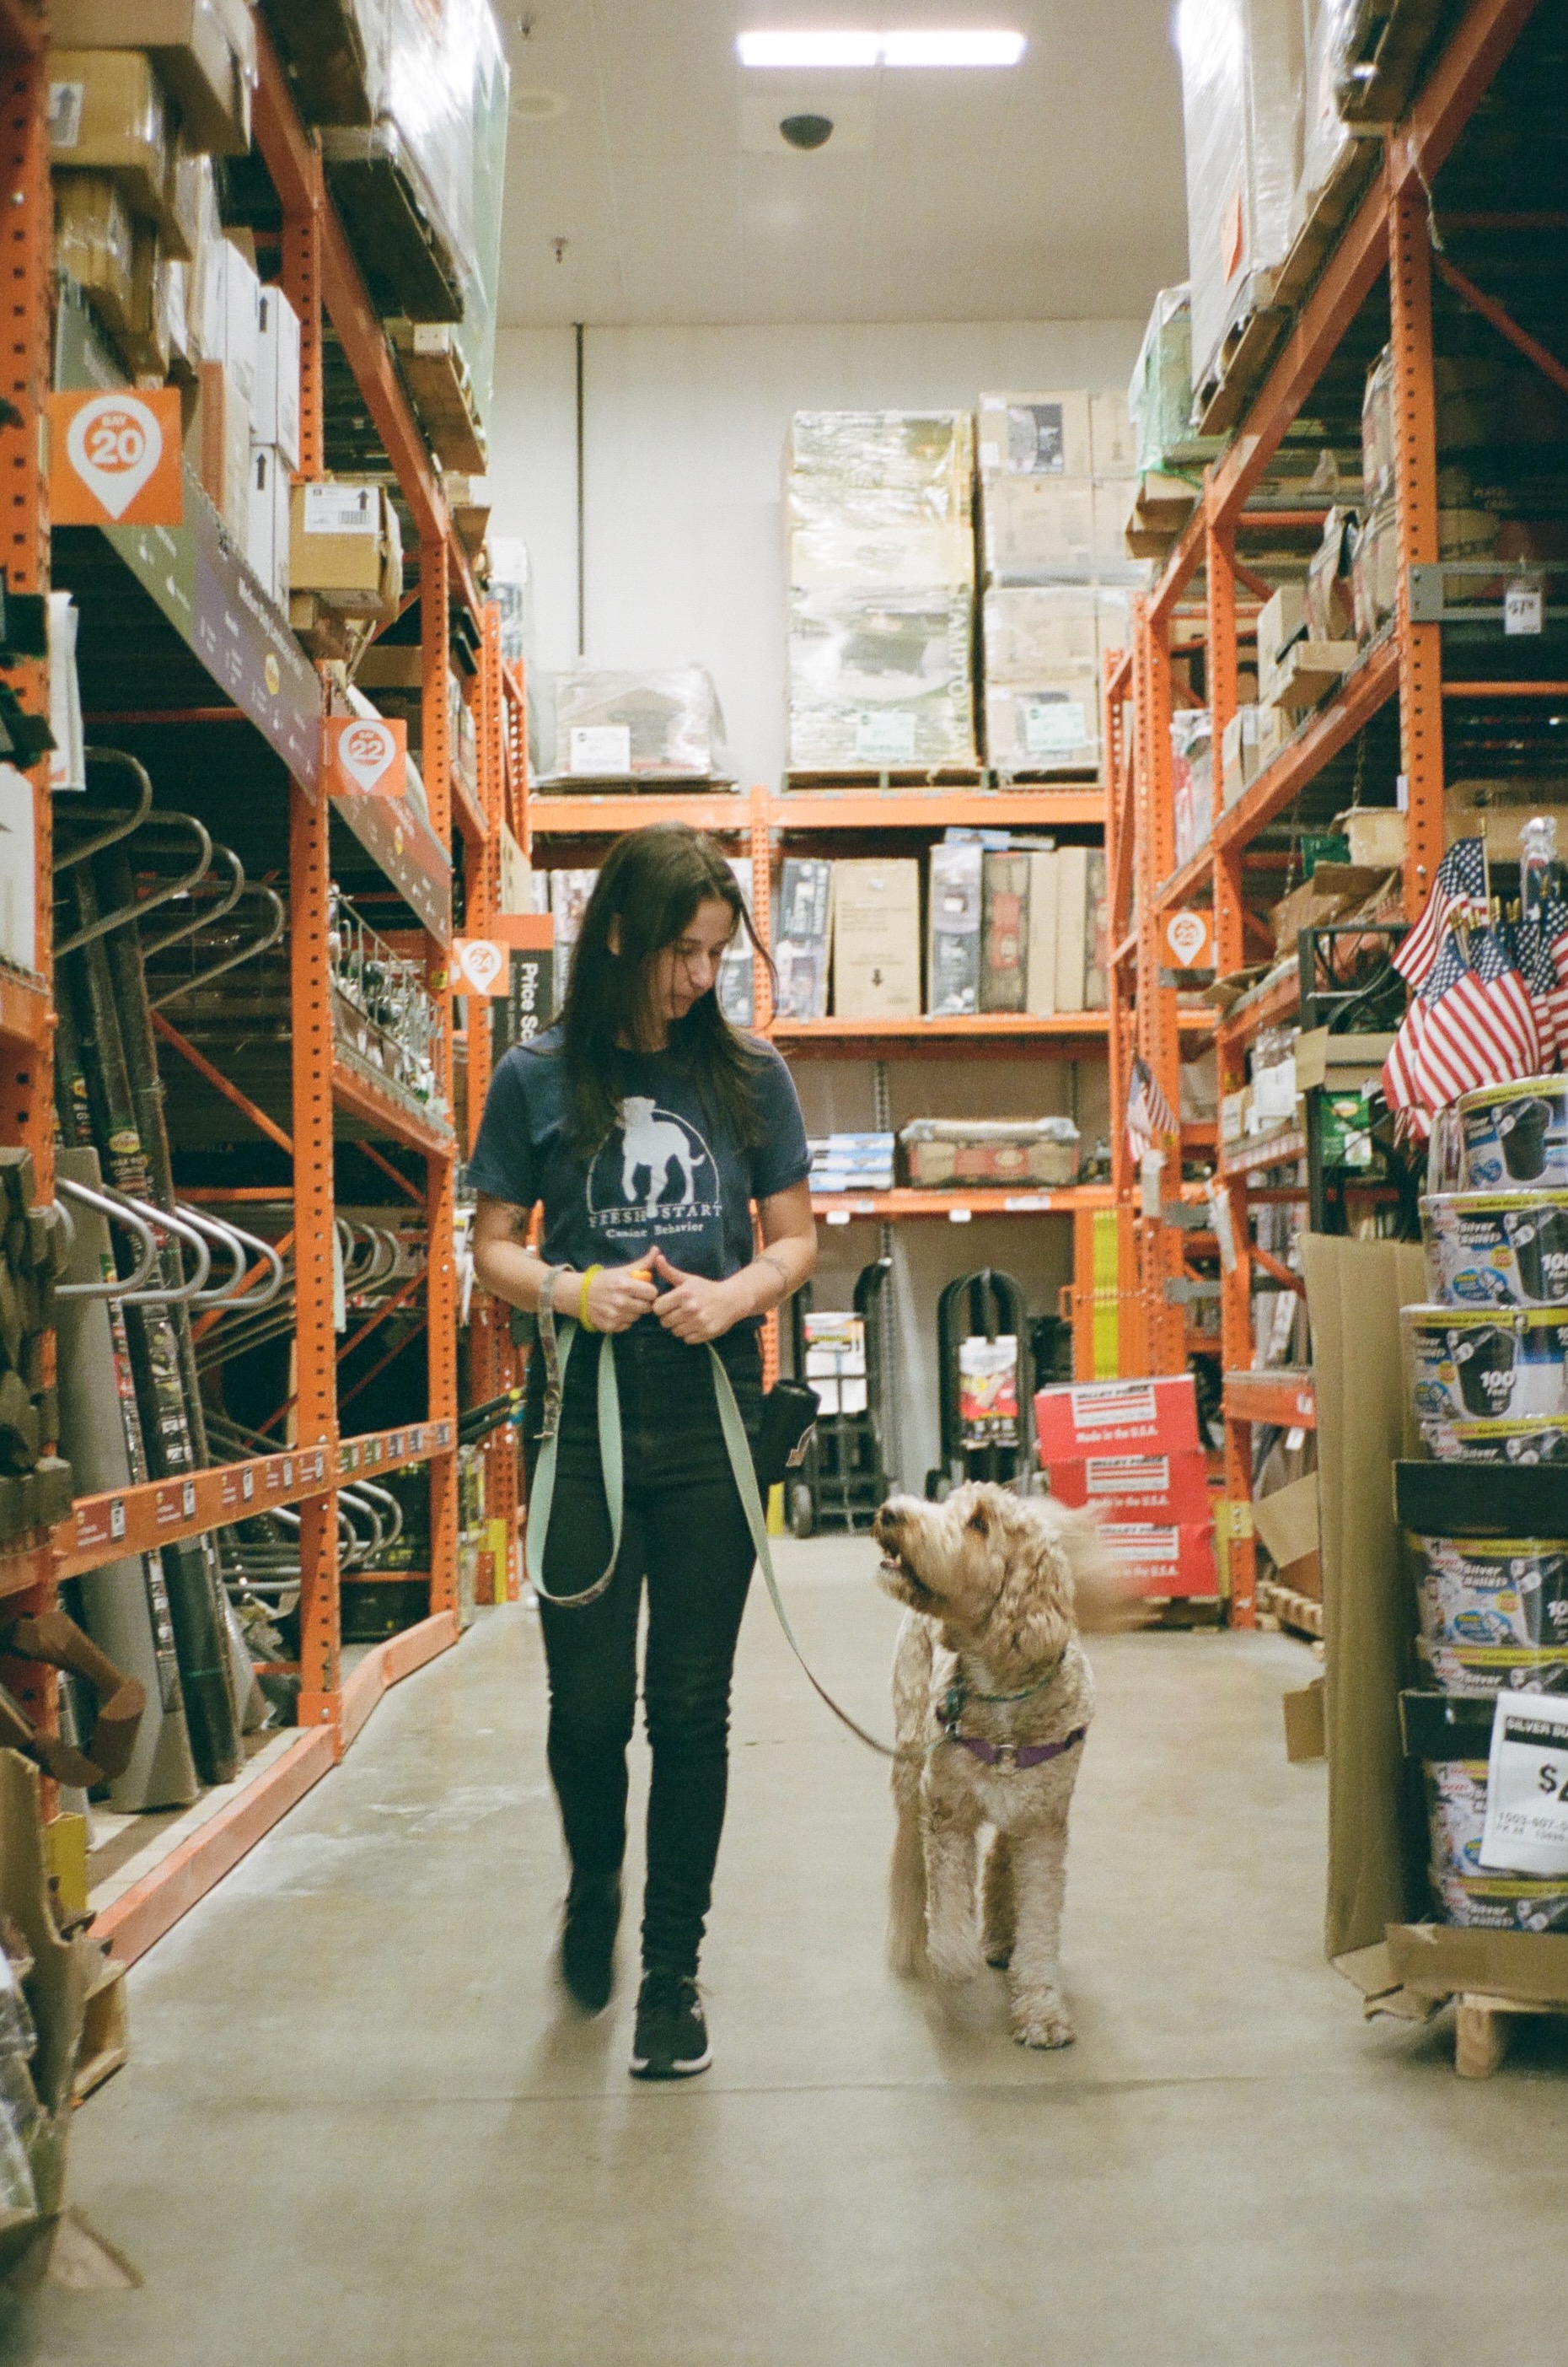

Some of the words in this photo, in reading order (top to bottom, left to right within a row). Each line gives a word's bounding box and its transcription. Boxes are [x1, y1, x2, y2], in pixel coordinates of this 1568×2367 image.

[91, 428, 144, 464] 20
[351, 740, 386, 760] 22
[470, 954, 494, 969] 24
[520, 963, 539, 1011] Price
[589, 1211, 647, 1228] FRESH
[662, 1204, 722, 1218] START
[605, 1228, 647, 1239] Canine
[653, 1222, 704, 1236] Behavior
[1479, 1370, 1517, 1390] 100
[1463, 1563, 1503, 1575] Silver
[1506, 1717, 1553, 1735] SILVER
